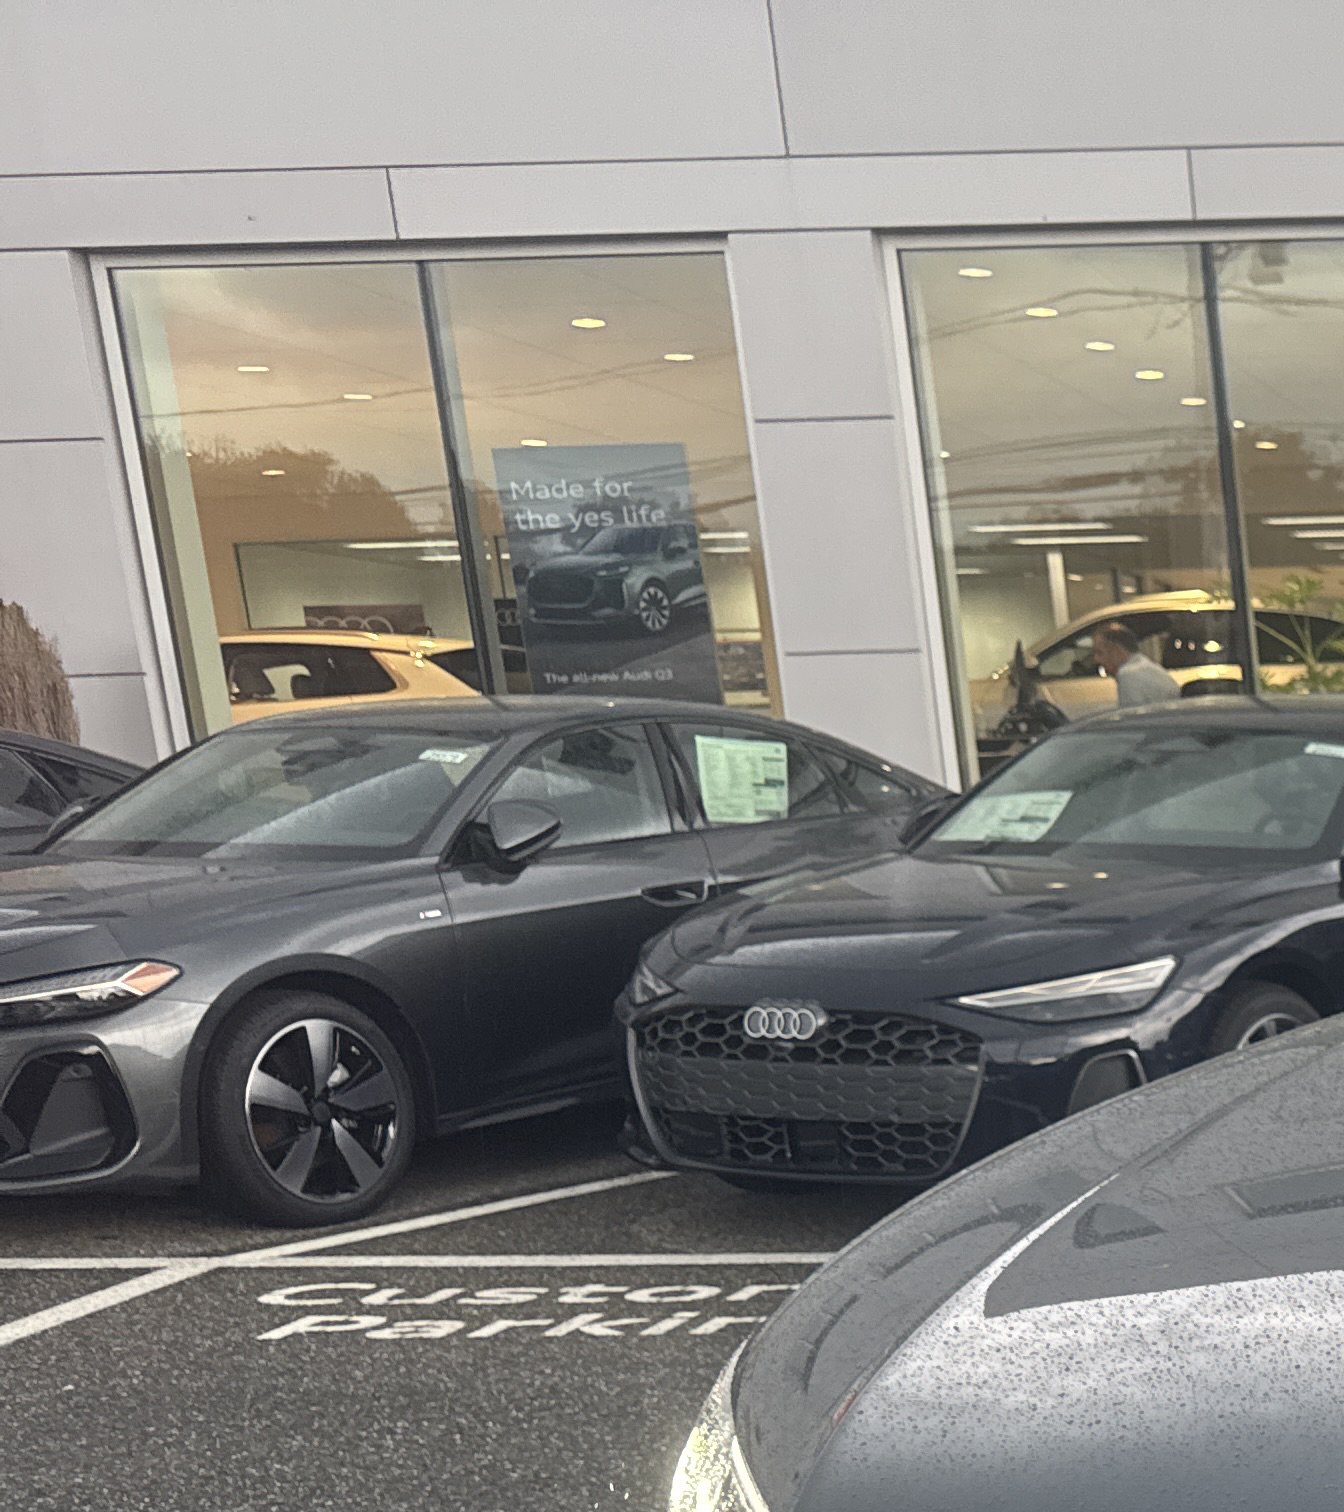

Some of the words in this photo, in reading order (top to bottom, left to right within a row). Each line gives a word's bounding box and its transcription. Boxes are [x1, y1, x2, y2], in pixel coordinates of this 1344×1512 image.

[510, 478, 585, 500] Made
[593, 476, 633, 497] for
[515, 508, 561, 530] the
[568, 510, 614, 533] yes
[622, 504, 667, 526] life
[544, 671, 569, 684] The
[623, 670, 652, 681] Audi
[655, 668, 673, 680] Q3
